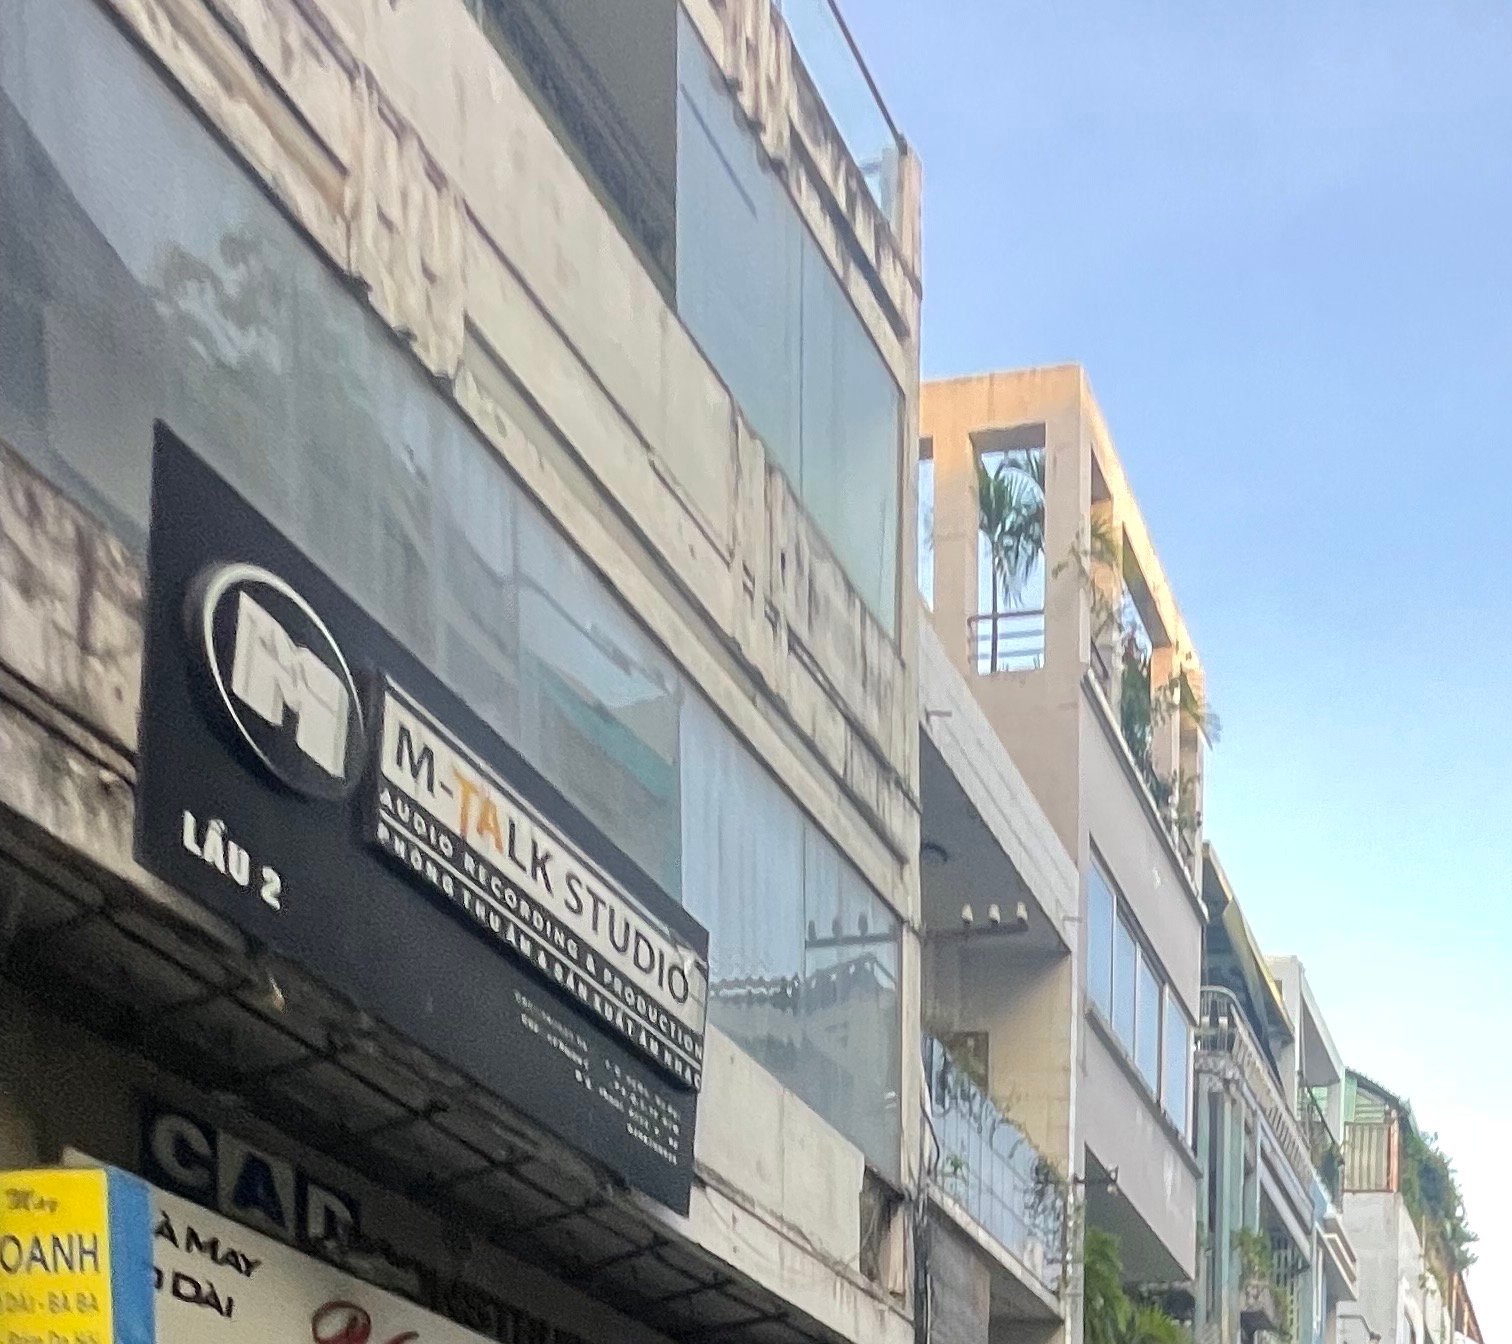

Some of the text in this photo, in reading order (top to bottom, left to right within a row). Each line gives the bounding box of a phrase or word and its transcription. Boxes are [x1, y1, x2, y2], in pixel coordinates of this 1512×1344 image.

[261, 866, 281, 911] 2
[396, 726, 689, 1004] M-TALK STUDIO
[380, 787, 453, 858] AUDIO
[464, 851, 578, 960] RECORDING
[603, 967, 702, 1060] PRODUCTION
[0, 1233, 99, 1274] OANH
[185, 1225, 262, 1279] MAY
[172, 1270, 234, 1318] DÀI
